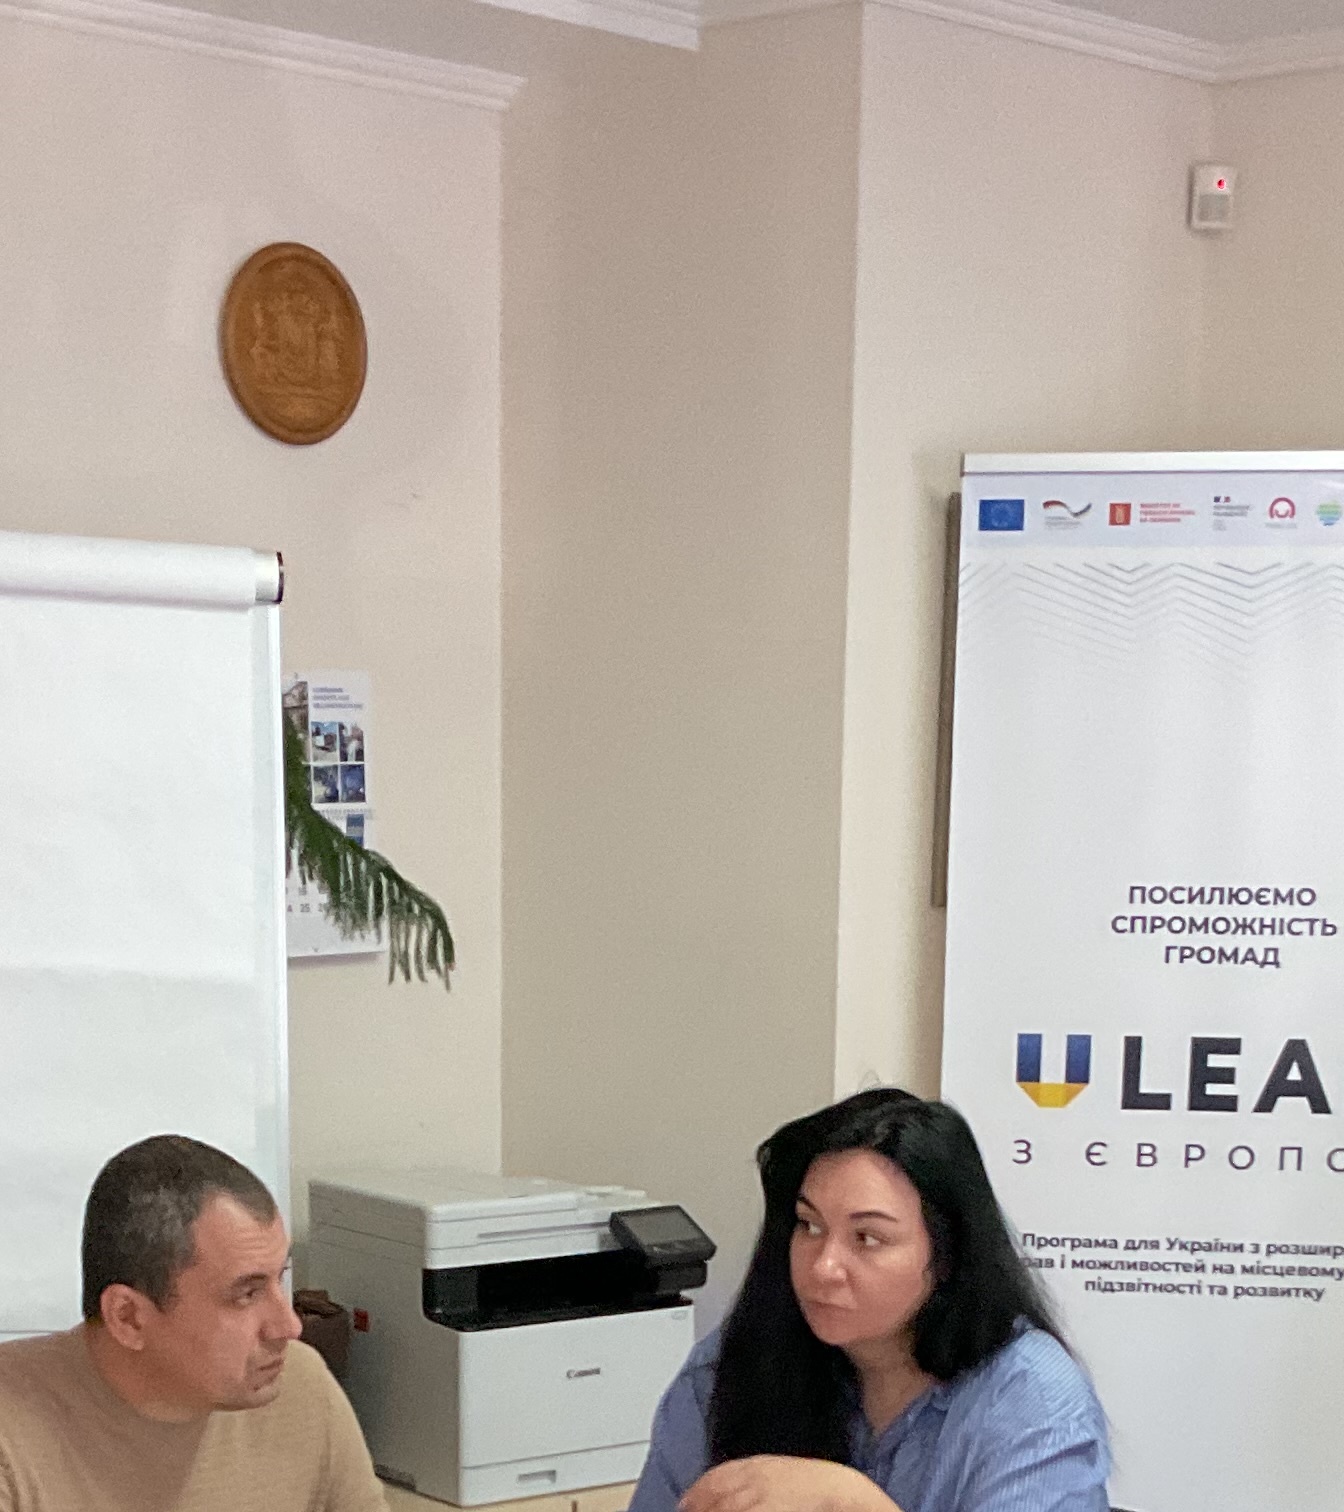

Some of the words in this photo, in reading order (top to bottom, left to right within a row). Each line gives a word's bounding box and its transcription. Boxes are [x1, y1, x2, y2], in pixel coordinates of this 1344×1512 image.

[1128, 885, 1318, 906] ПОСИЛЮЄМО
[1110, 915, 1338, 937] СПРОМОЖНІСТЬ
[1164, 945, 1281, 969] ГРОМАД
[1022, 1233, 1119, 1251] Програма
[1123, 1238, 1160, 1252] для
[1165, 1237, 1244, 1256] України
[1249, 1242, 1261, 1254] з
[1019, 1257, 1054, 1270] рав
[1071, 1259, 1206, 1274] можливостей
[1212, 1263, 1235, 1275] на
[1085, 1276, 1202, 1294] підзвітності
[1207, 1284, 1228, 1296] та
[1233, 1285, 1325, 1302] розвитку
[566, 1367, 602, 1379] Canon
